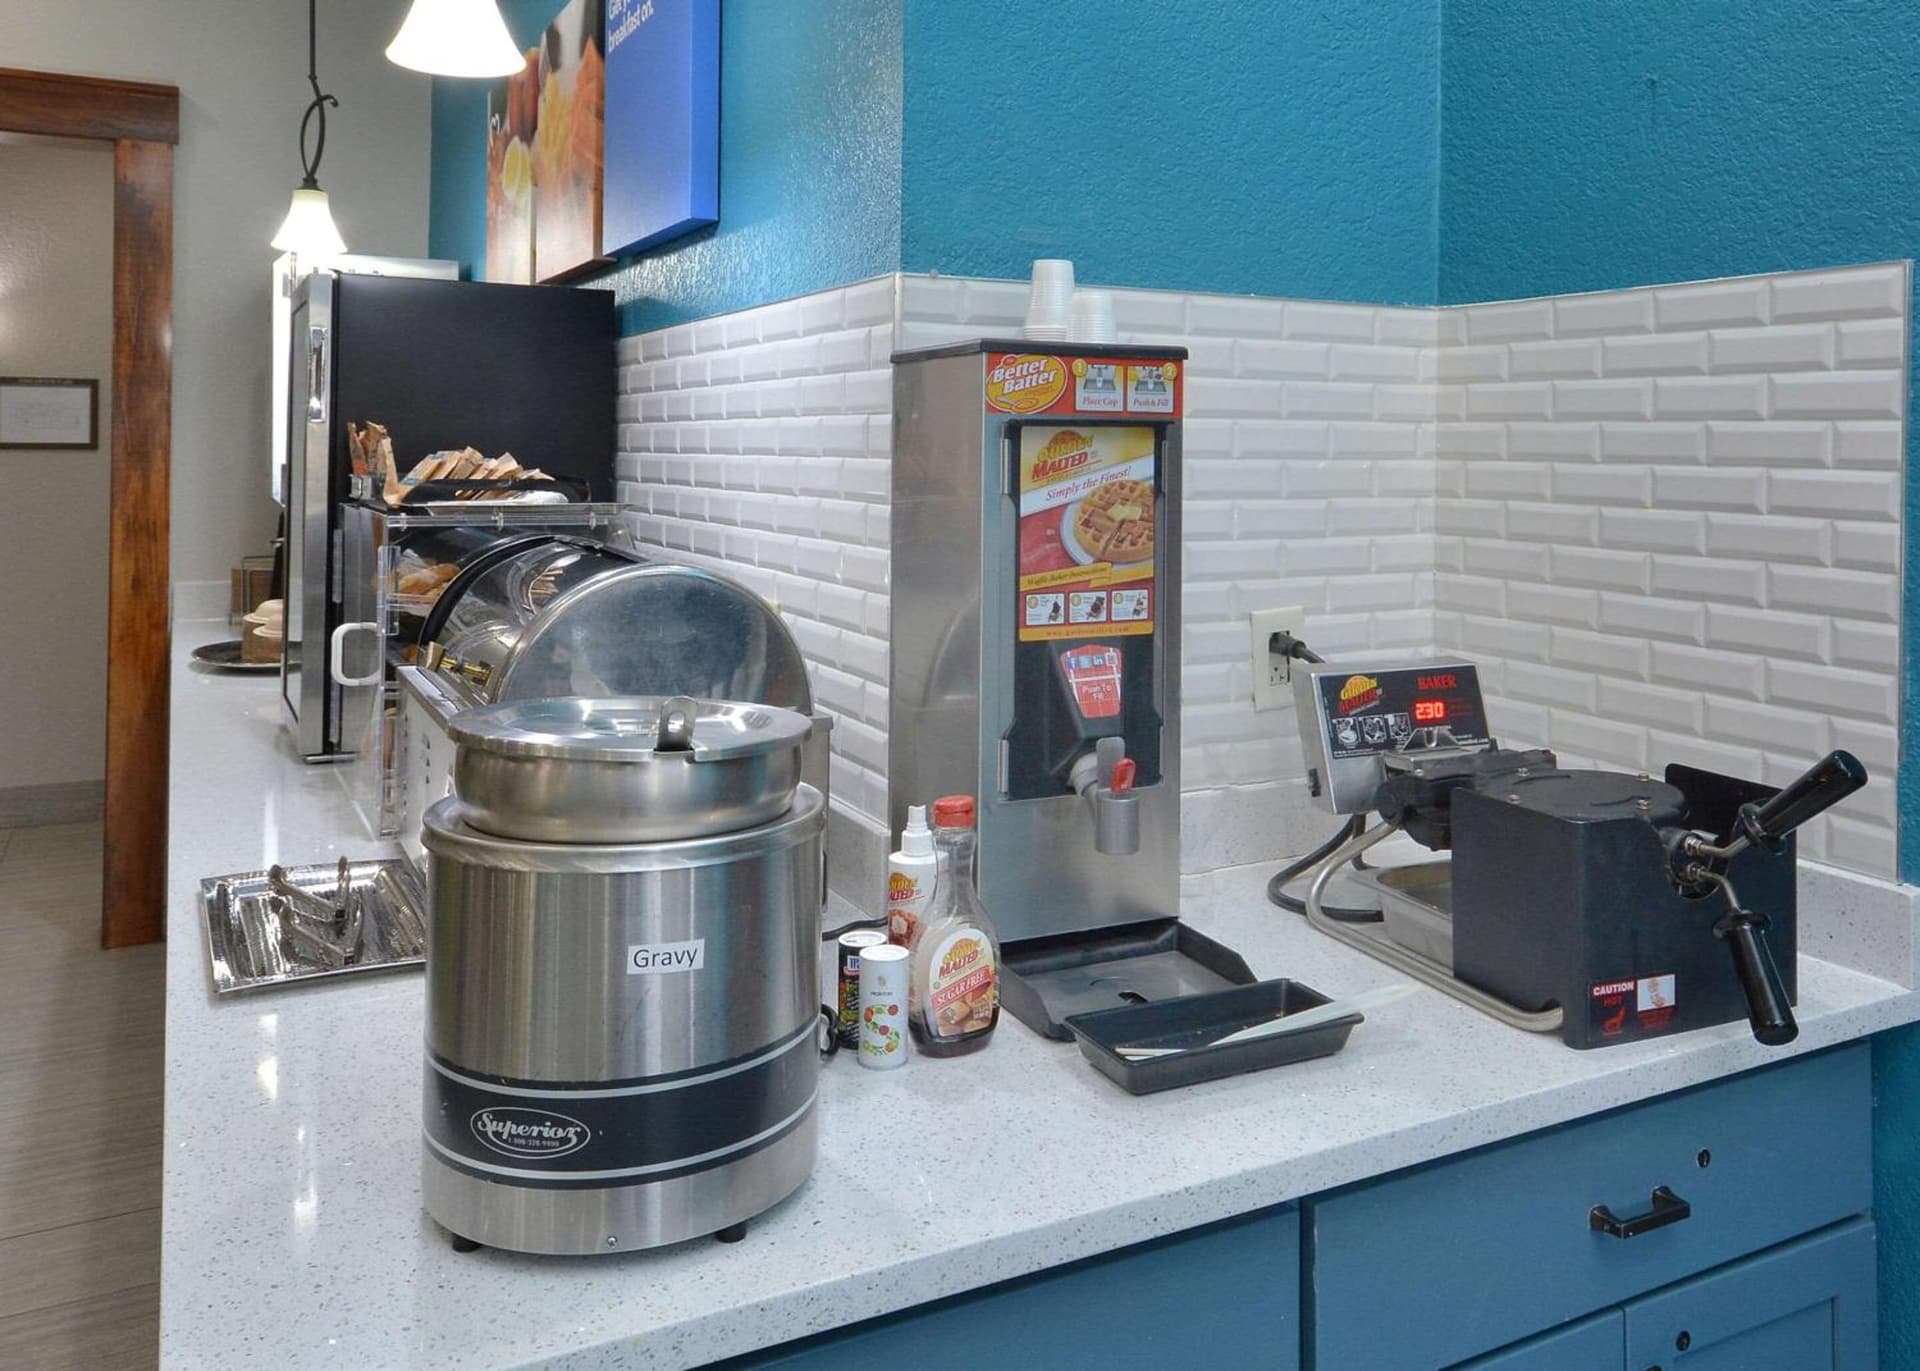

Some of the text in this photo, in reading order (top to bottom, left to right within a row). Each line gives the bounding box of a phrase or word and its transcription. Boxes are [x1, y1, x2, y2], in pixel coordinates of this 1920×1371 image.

[994, 358, 1048, 383] Better
[1003, 369, 1057, 394] Batter
[1032, 451, 1089, 481] MALTED
[1046, 482, 1080, 502] Simply
[1082, 477, 1097, 490] the
[1099, 465, 1132, 484] Finest!
[1417, 675, 1457, 690] BAKER
[1415, 701, 1444, 719] 230
[633, 948, 698, 968] Gravy
[937, 982, 966, 1006] SUGAR
[965, 972, 985, 989] FREE
[1593, 981, 1635, 996] CAUTION
[477, 1112, 582, 1147] Superior
